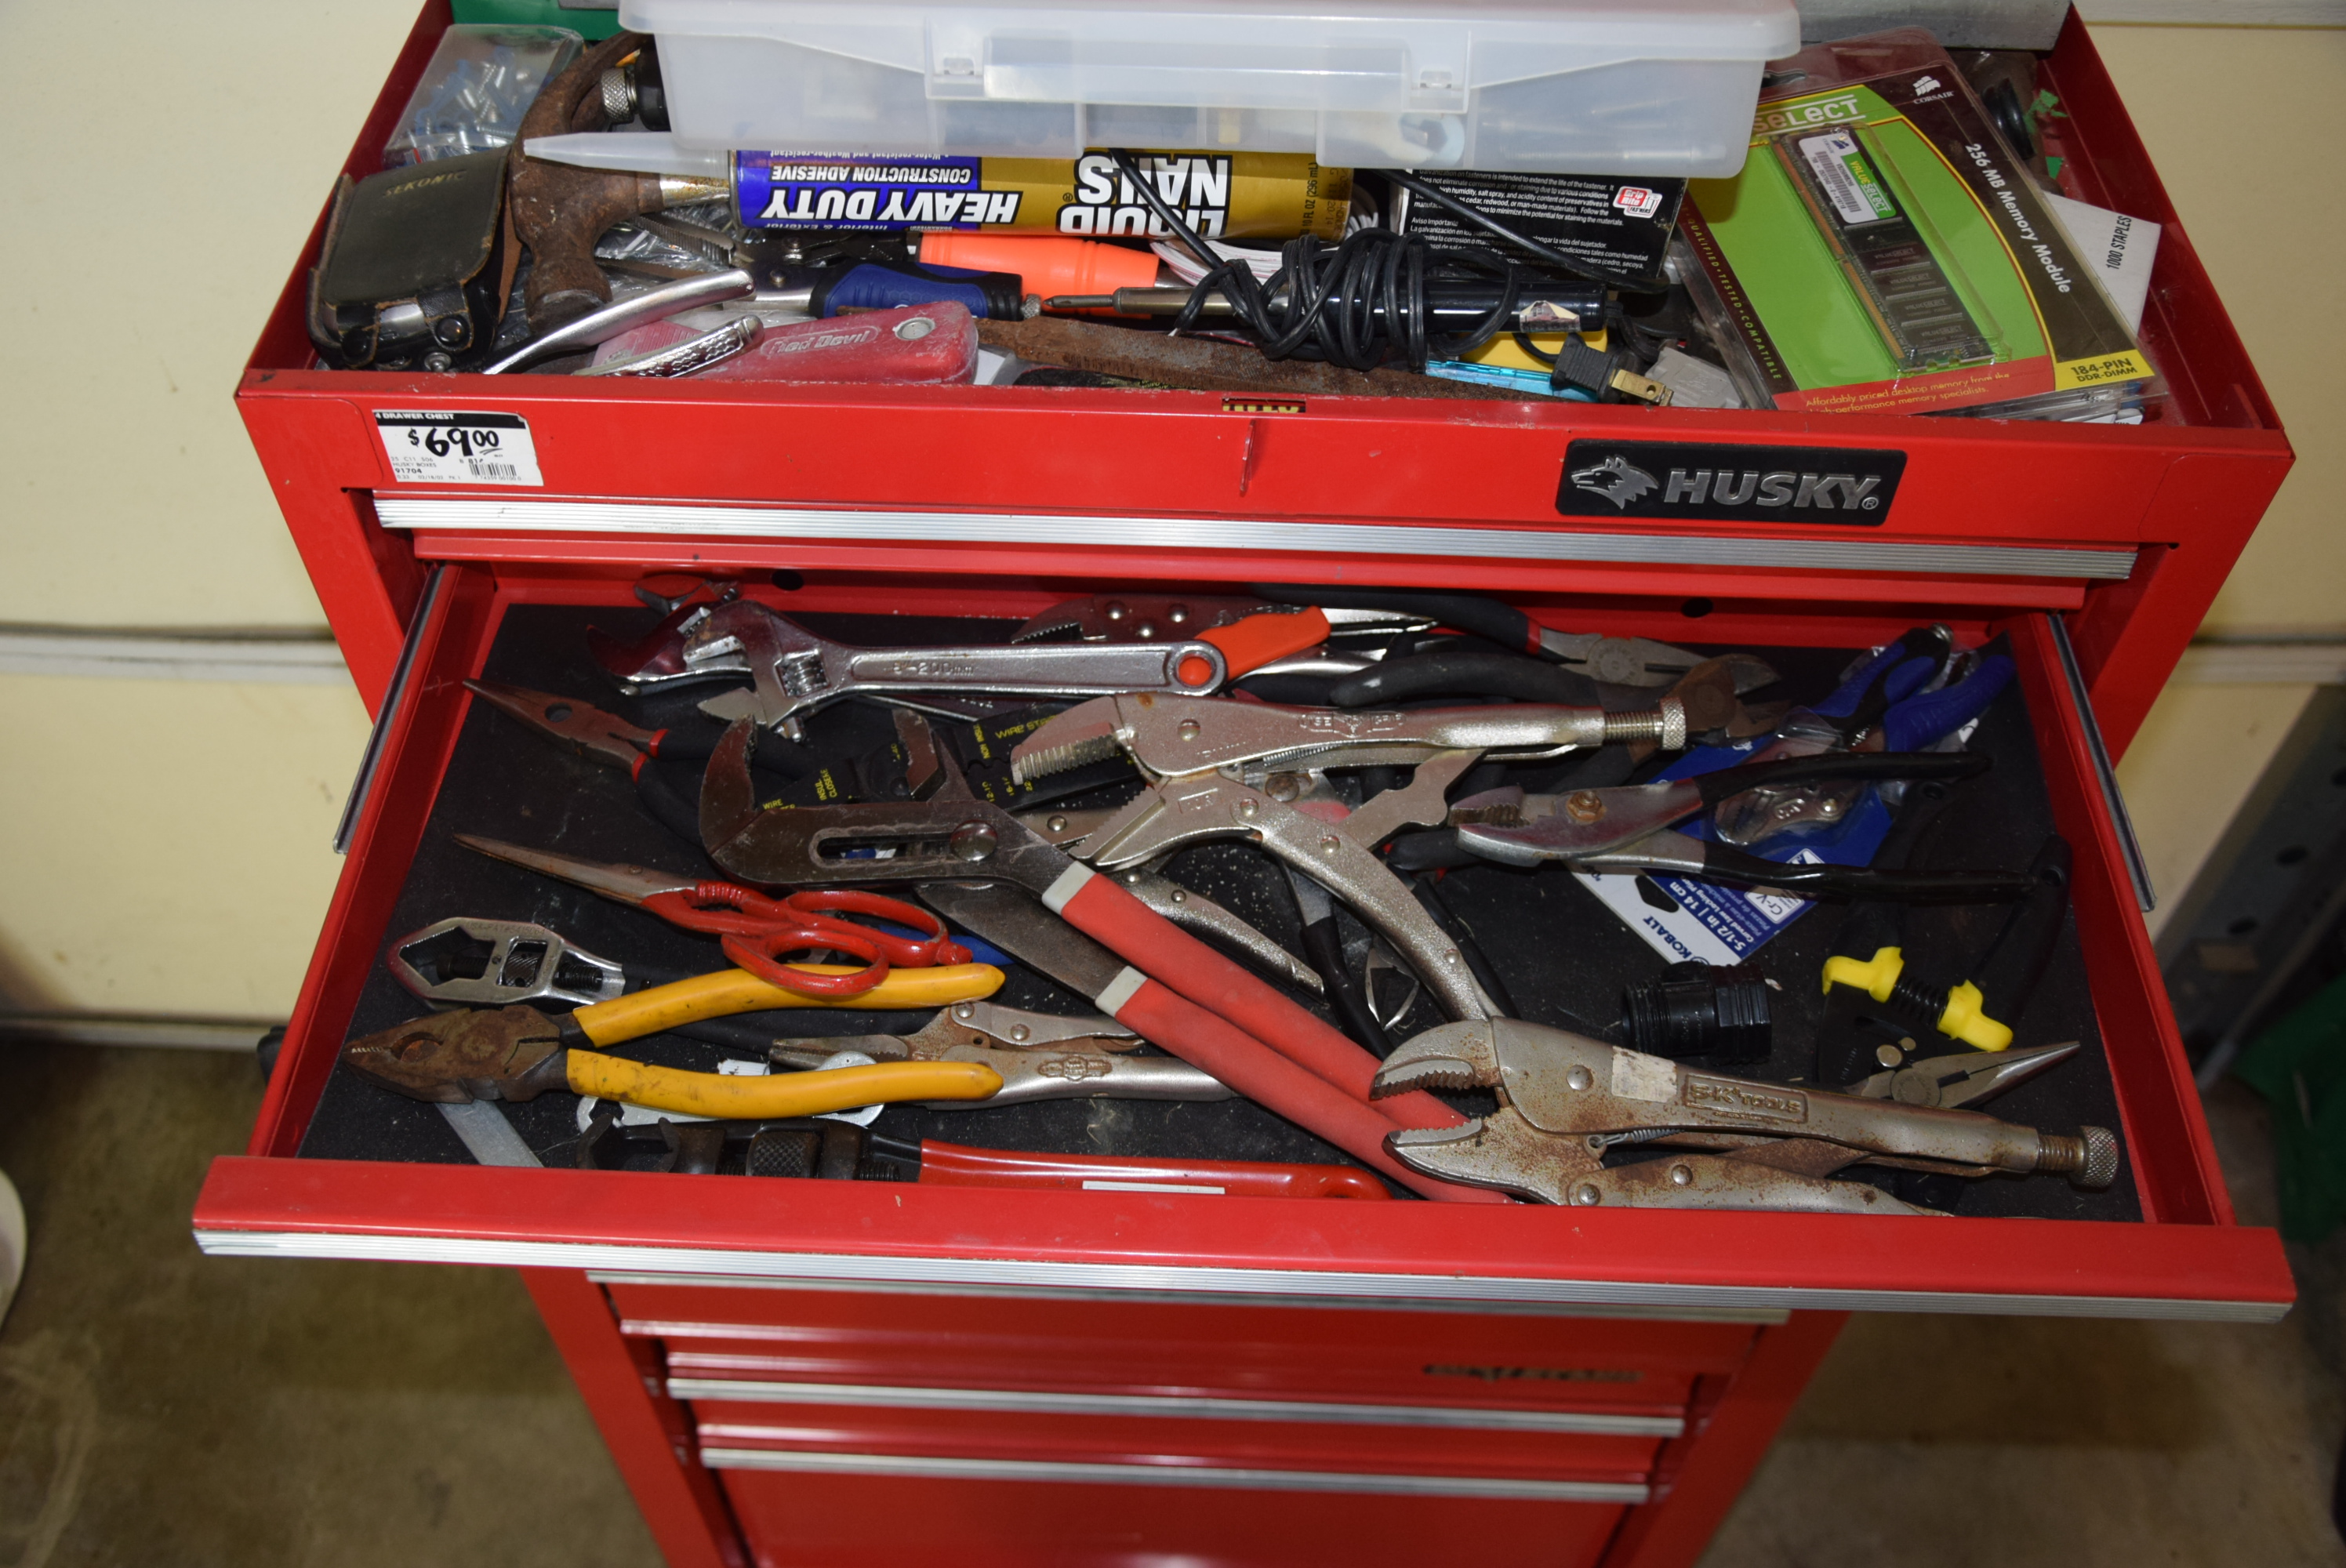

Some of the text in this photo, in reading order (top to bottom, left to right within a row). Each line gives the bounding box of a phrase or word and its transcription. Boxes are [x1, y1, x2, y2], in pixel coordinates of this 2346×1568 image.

[1913, 91, 1954, 104] CORSAIR
[771, 165, 971, 183] CONSTRUCTION ADHESIVE
[1077, 155, 1229, 207] NAILS
[1466, 170, 1491, 180] fasteners
[1498, 173, 1522, 182] intended
[1529, 176, 1548, 184] extend
[1549, 177, 1557, 186] the
[1558, 178, 1567, 187] life
[1567, 179, 1574, 187] of
[1584, 180, 1607, 191] fastener.
[1306, 179, 1319, 198] (296
[1443, 178, 1468, 187] eliminate
[1469, 180, 1495, 189] corrosion
[1517, 183, 1539, 194] staining
[1540, 185, 1551, 194] due
[1558, 187, 1579, 196] various
[1579, 189, 1609, 200] conditions
[1452, 187, 1477, 197] humidity,
[1489, 191, 1506, 200] spray,
[1518, 193, 1537, 202] acidity
[1537, 194, 1559, 203] content
[1564, 198, 1603, 208] preservatives
[1624, 189, 1645, 200] Grip
[760, 189, 1020, 223] HEAVY DUTY
[1304, 199, 1316, 210] OZ
[1483, 198, 1509, 208] redwood,
[1517, 201, 1548, 210] man-made
[1580, 205, 1600, 214] Follow
[1620, 196, 1641, 206] Rite
[1303, 210, 1315, 220] FL
[1497, 208, 1522, 216] minimize
[1531, 211, 1556, 220] potential
[1564, 214, 1587, 223] staining
[1965, 143, 2072, 293] 256 MB Memory Module
[2105, 215, 2132, 270] 1000 STAPLES
[1591, 249, 1604, 257] tales
[1622, 252, 1649, 262] humedad
[1718, 274, 1742, 309] TESTED
[1741, 315, 1781, 380] COMPATIBLE
[814, 330, 870, 350] Devil
[2071, 358, 2133, 376] 184-PIN
[2076, 366, 2138, 383] DDR-DIMM
[1806, 392, 1858, 408] Affordably
[1858, 388, 1890, 403] priced
[1890, 383, 1929, 398] desktop
[1930, 379, 1969, 394] memory
[1969, 375, 1993, 387] from
[1898, 393, 1937, 407] memory
[1938, 387, 1990, 401] specialists.
[1663, 468, 1881, 510] HUSKY
[995, 724, 1025, 739] WIRE
[762, 799, 783, 810] WIRE
[1669, 881, 1747, 953] 5-1/2 in 14 cm
[1643, 914, 1694, 962] KOBALT
